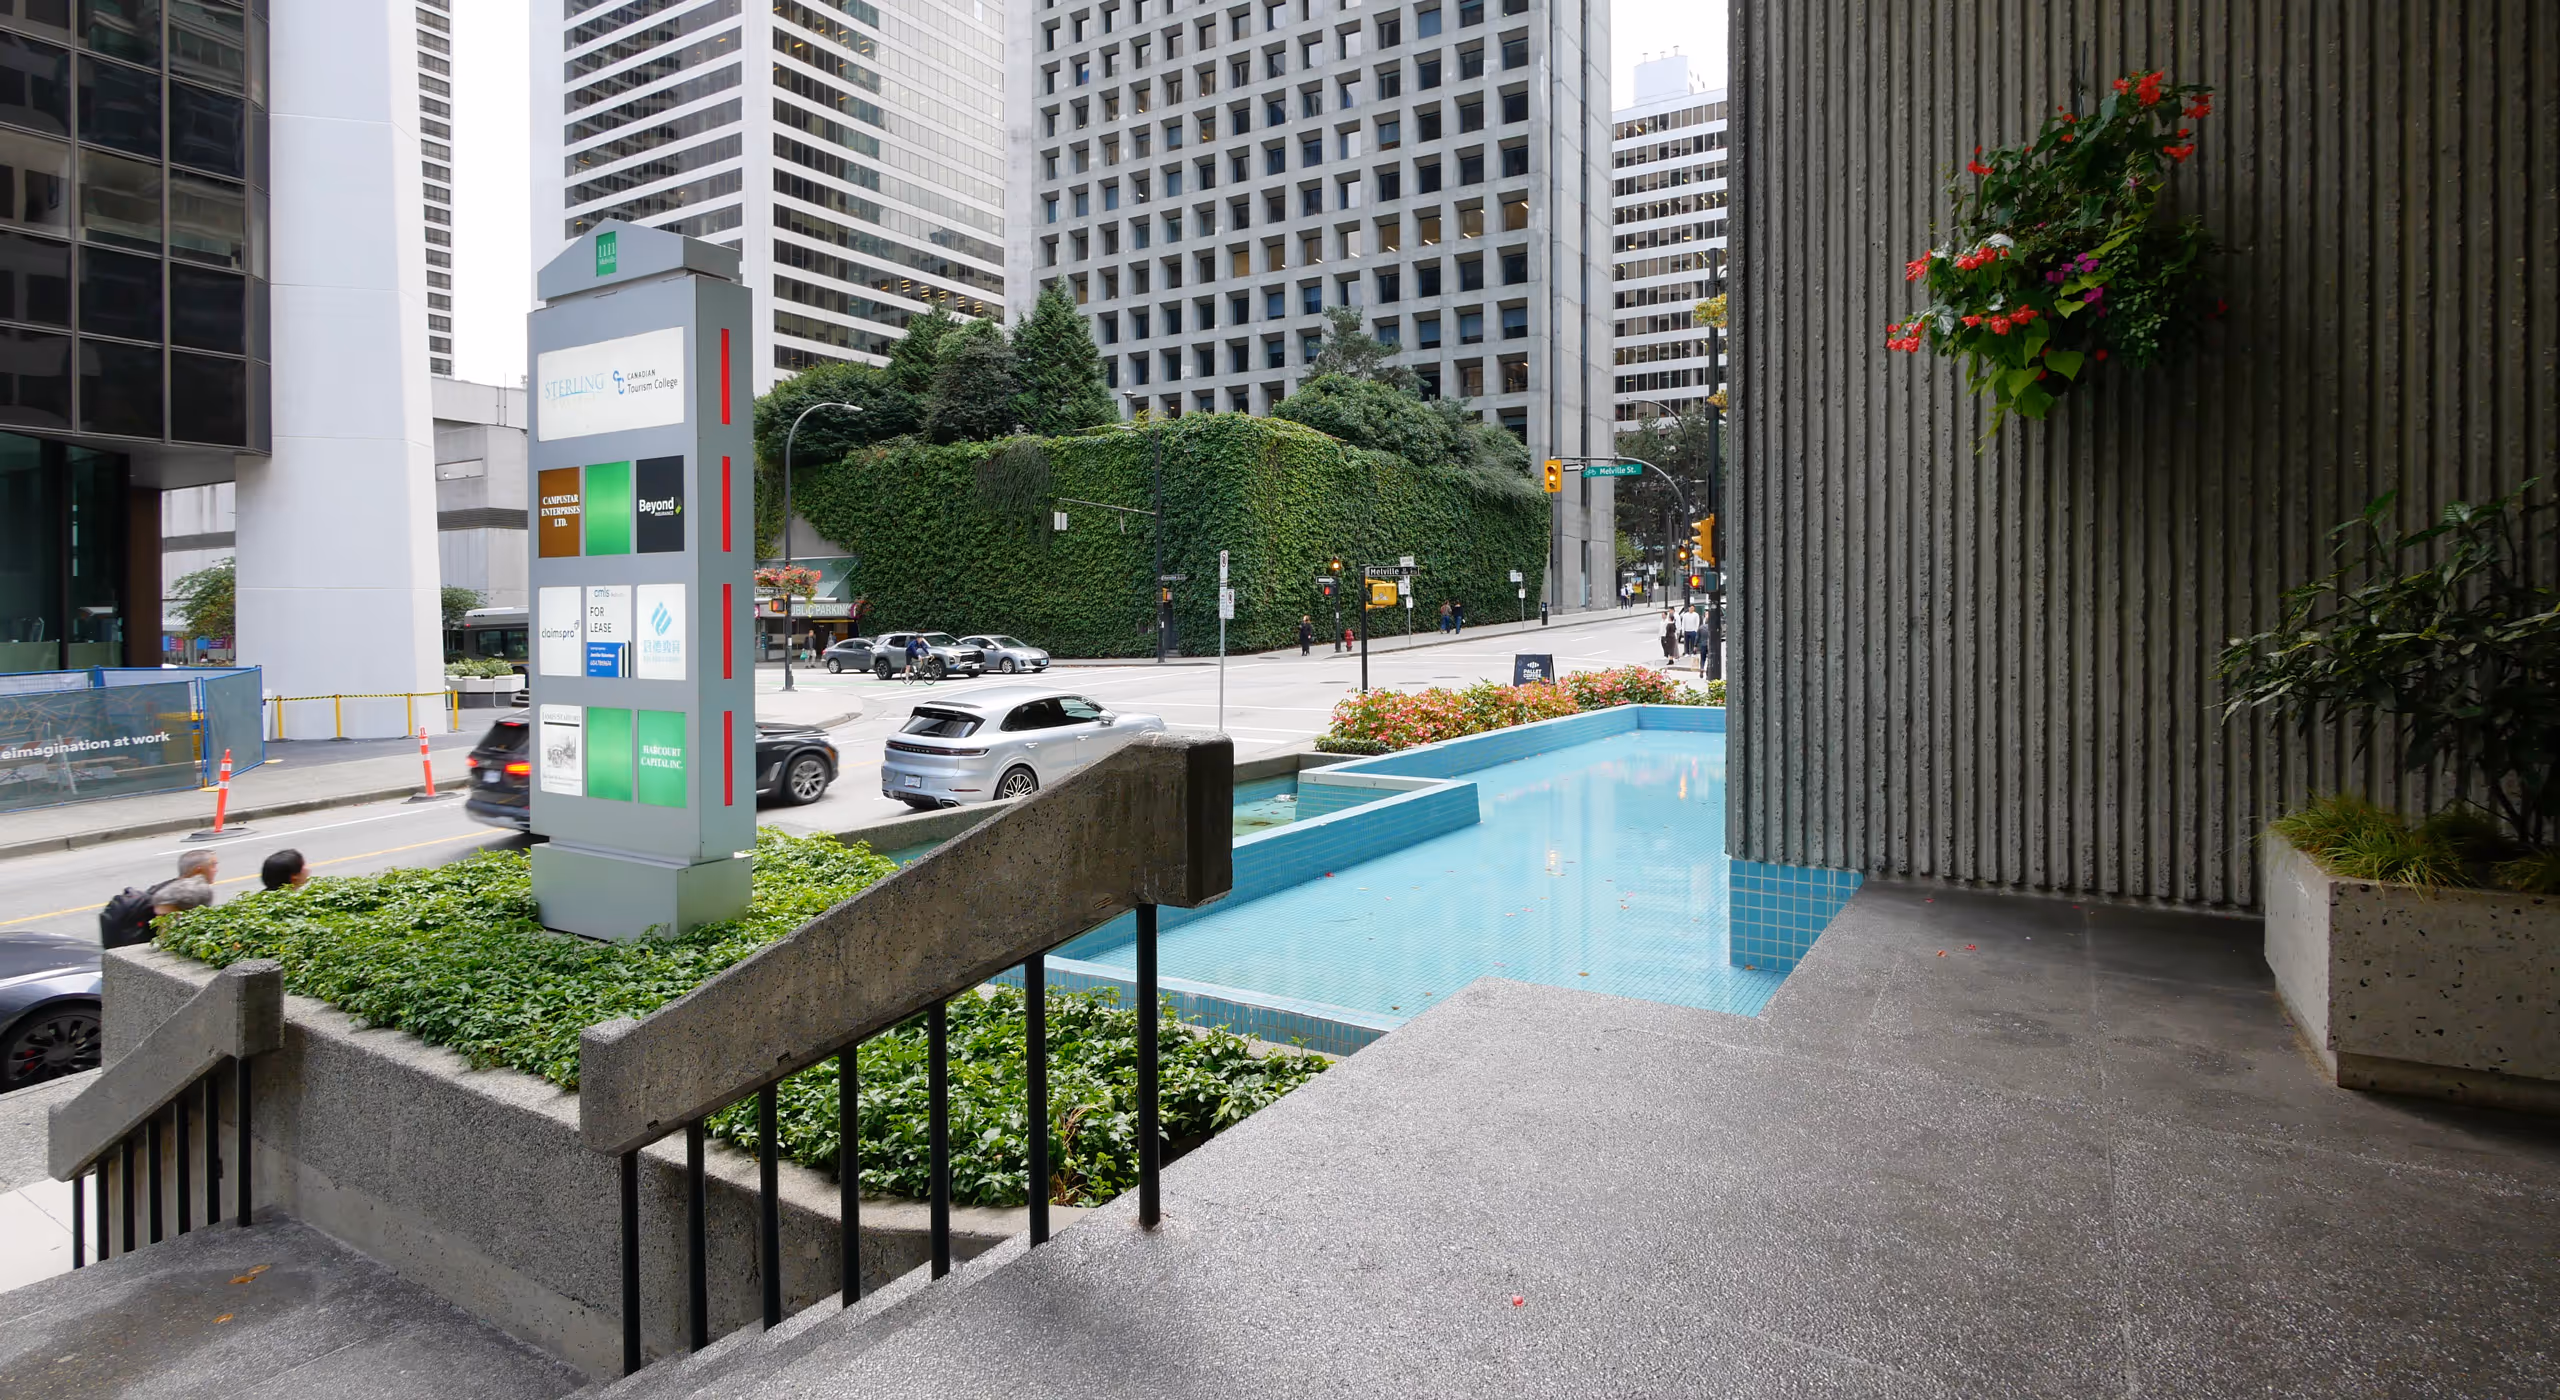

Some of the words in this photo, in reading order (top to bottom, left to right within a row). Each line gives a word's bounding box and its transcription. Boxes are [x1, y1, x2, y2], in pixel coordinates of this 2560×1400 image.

[627, 369, 656, 381] CANADIAN
[544, 373, 605, 400] STERLING
[627, 380, 653, 395] Tourism
[654, 377, 678, 390] College
[1600, 466, 1626, 475] Melville
[1627, 465, 1637, 474] St.
[542, 494, 579, 506] CAMPUSTAR
[639, 496, 675, 515] Beyond
[541, 505, 581, 517] ENTERPRISES
[554, 517, 568, 528] LTD.
[1370, 567, 1400, 576] Melville
[590, 606, 605, 617] FOR
[791, 603, 815, 616] UBLIC
[590, 622, 612, 633] LEASE
[541, 628, 575, 641] claimspro
[113, 735, 130, 748] at
[132, 731, 170, 745] work
[642, 744, 682, 758] HARCOURT
[641, 756, 670, 768] CAPITAL
